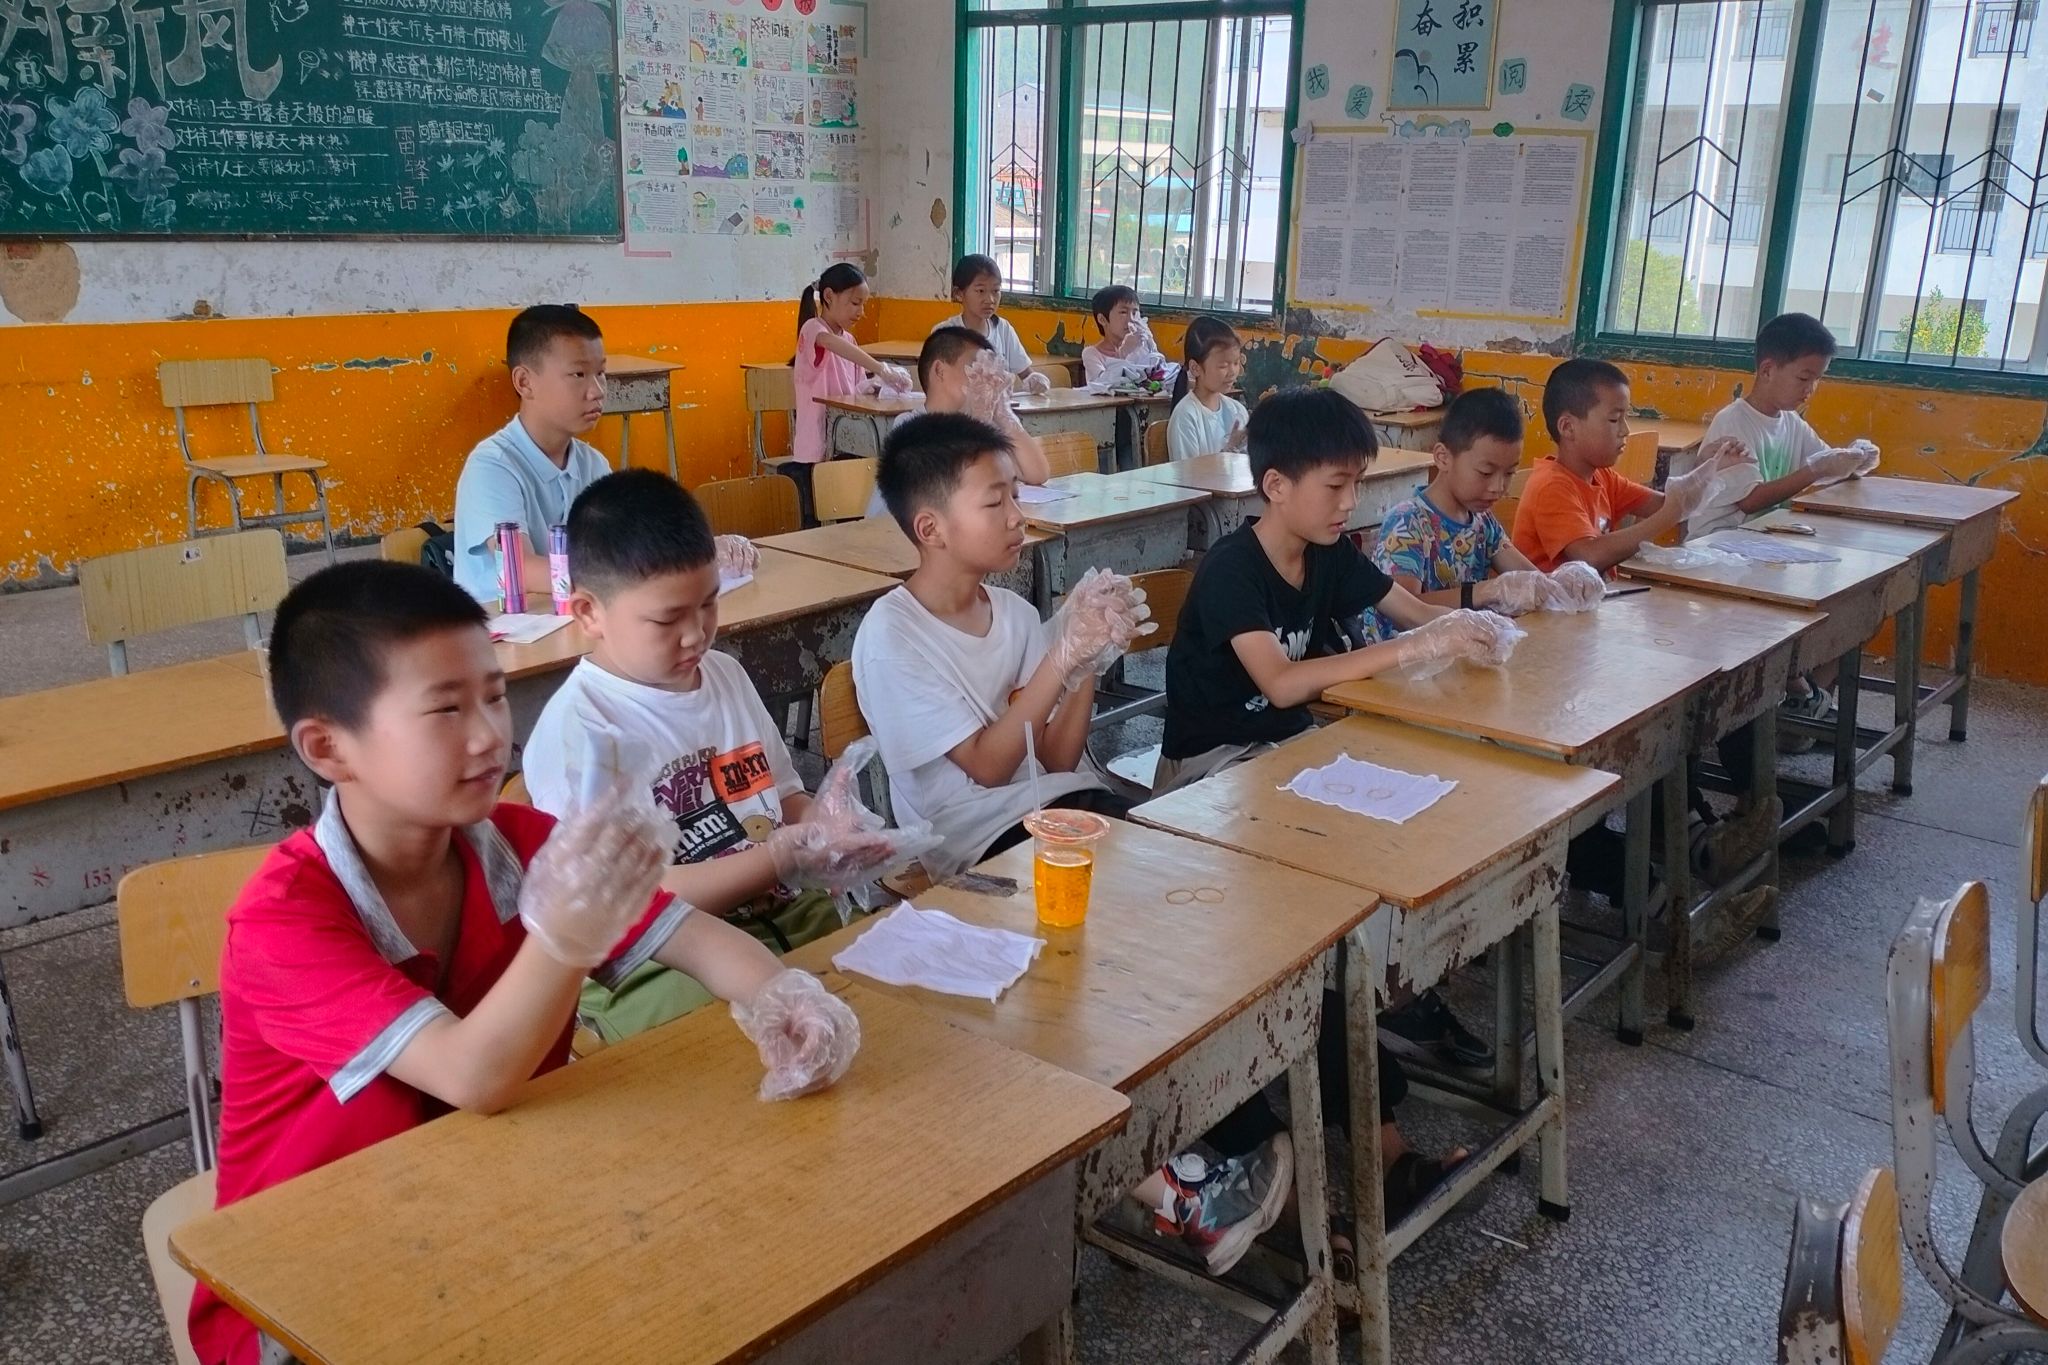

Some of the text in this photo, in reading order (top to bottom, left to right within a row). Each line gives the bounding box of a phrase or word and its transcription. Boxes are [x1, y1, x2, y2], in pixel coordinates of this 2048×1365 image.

[1410, 0, 1442, 36] 奋
[1452, 0, 1484, 74] 积累
[1308, 62, 1592, 118] 我 爱 阅 读
